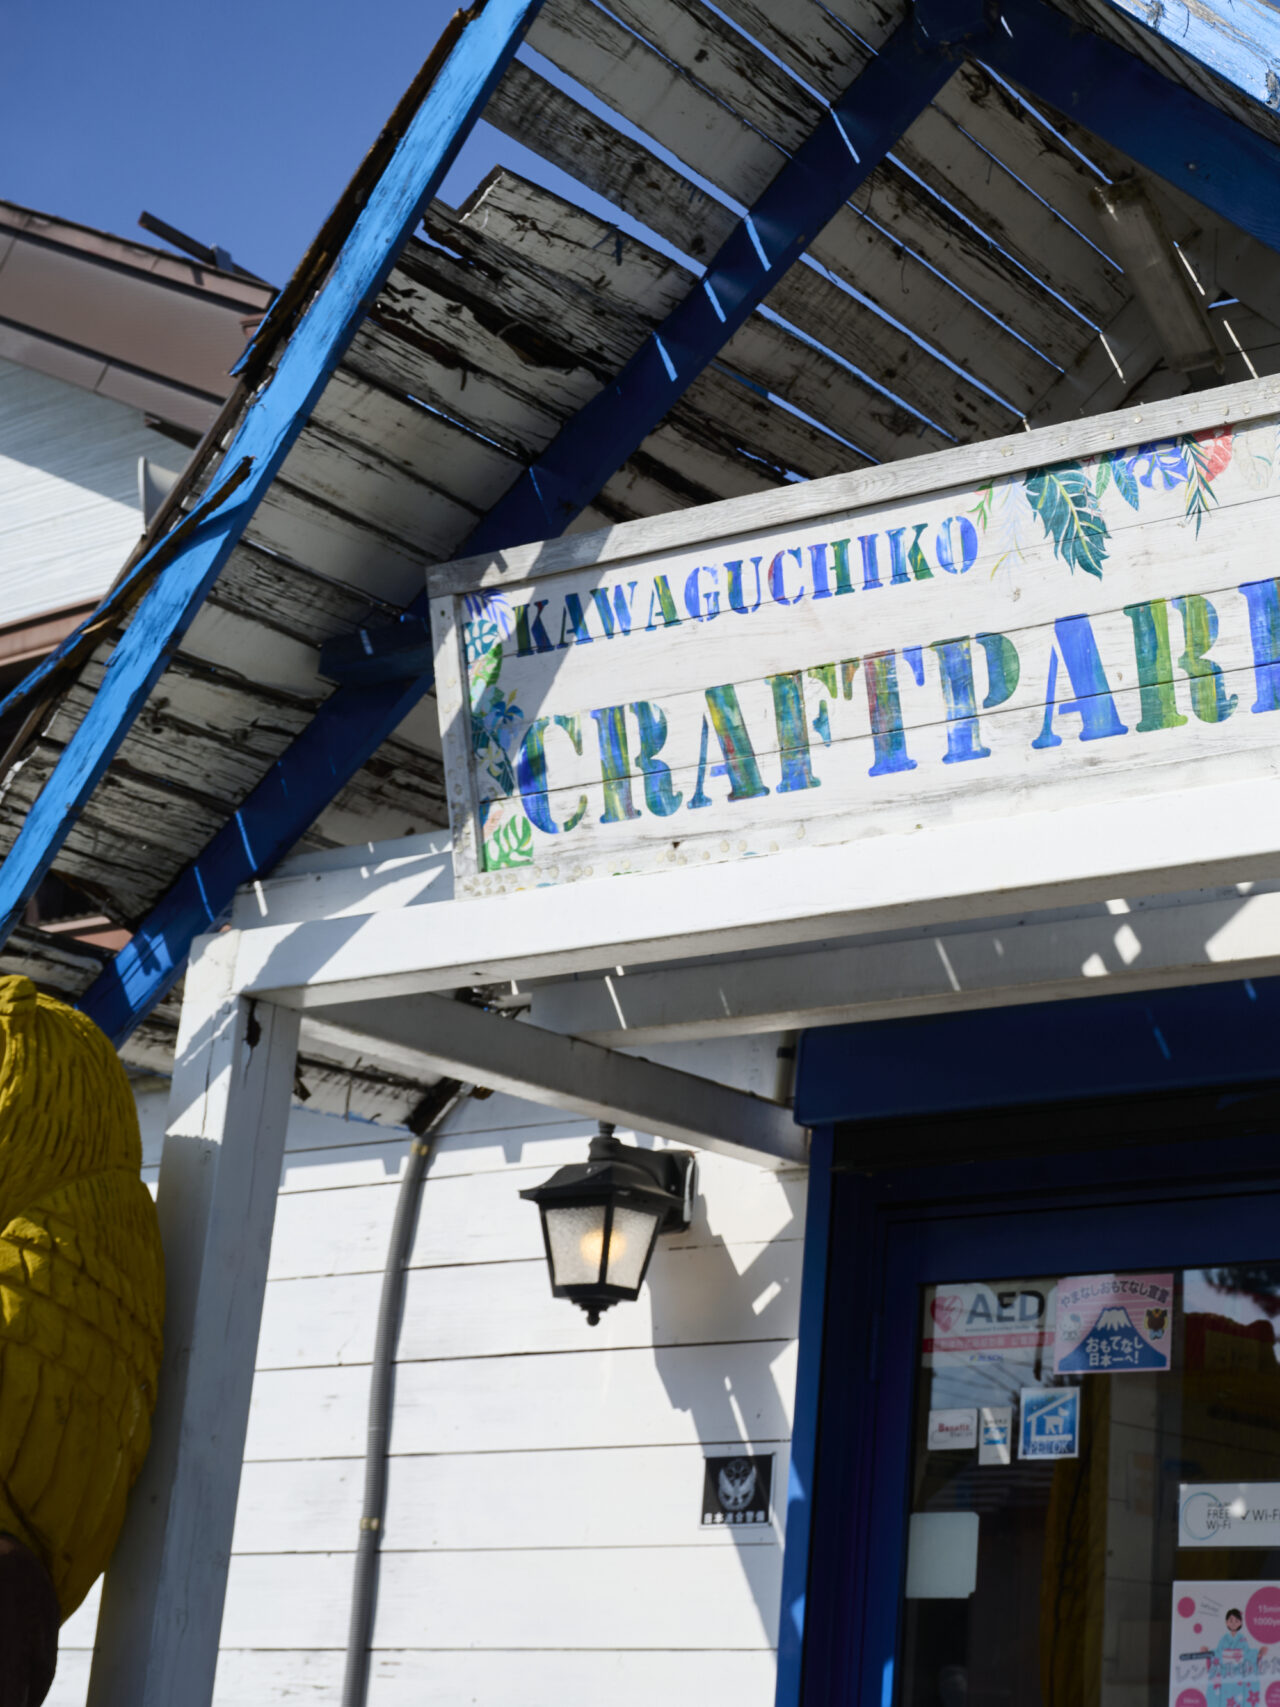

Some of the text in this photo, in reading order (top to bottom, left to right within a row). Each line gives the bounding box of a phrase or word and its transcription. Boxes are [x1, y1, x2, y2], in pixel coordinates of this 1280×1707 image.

[514, 515, 979, 657] KAWAGUCHIKO
[966, 1290, 1045, 1325] AED
[1085, 1336, 1144, 1353] おもてなし
[1053, 1441, 1069, 1453] OK
[1207, 1509, 1230, 1519] FREE
[1206, 1520, 1231, 1530] Wi-Fi
